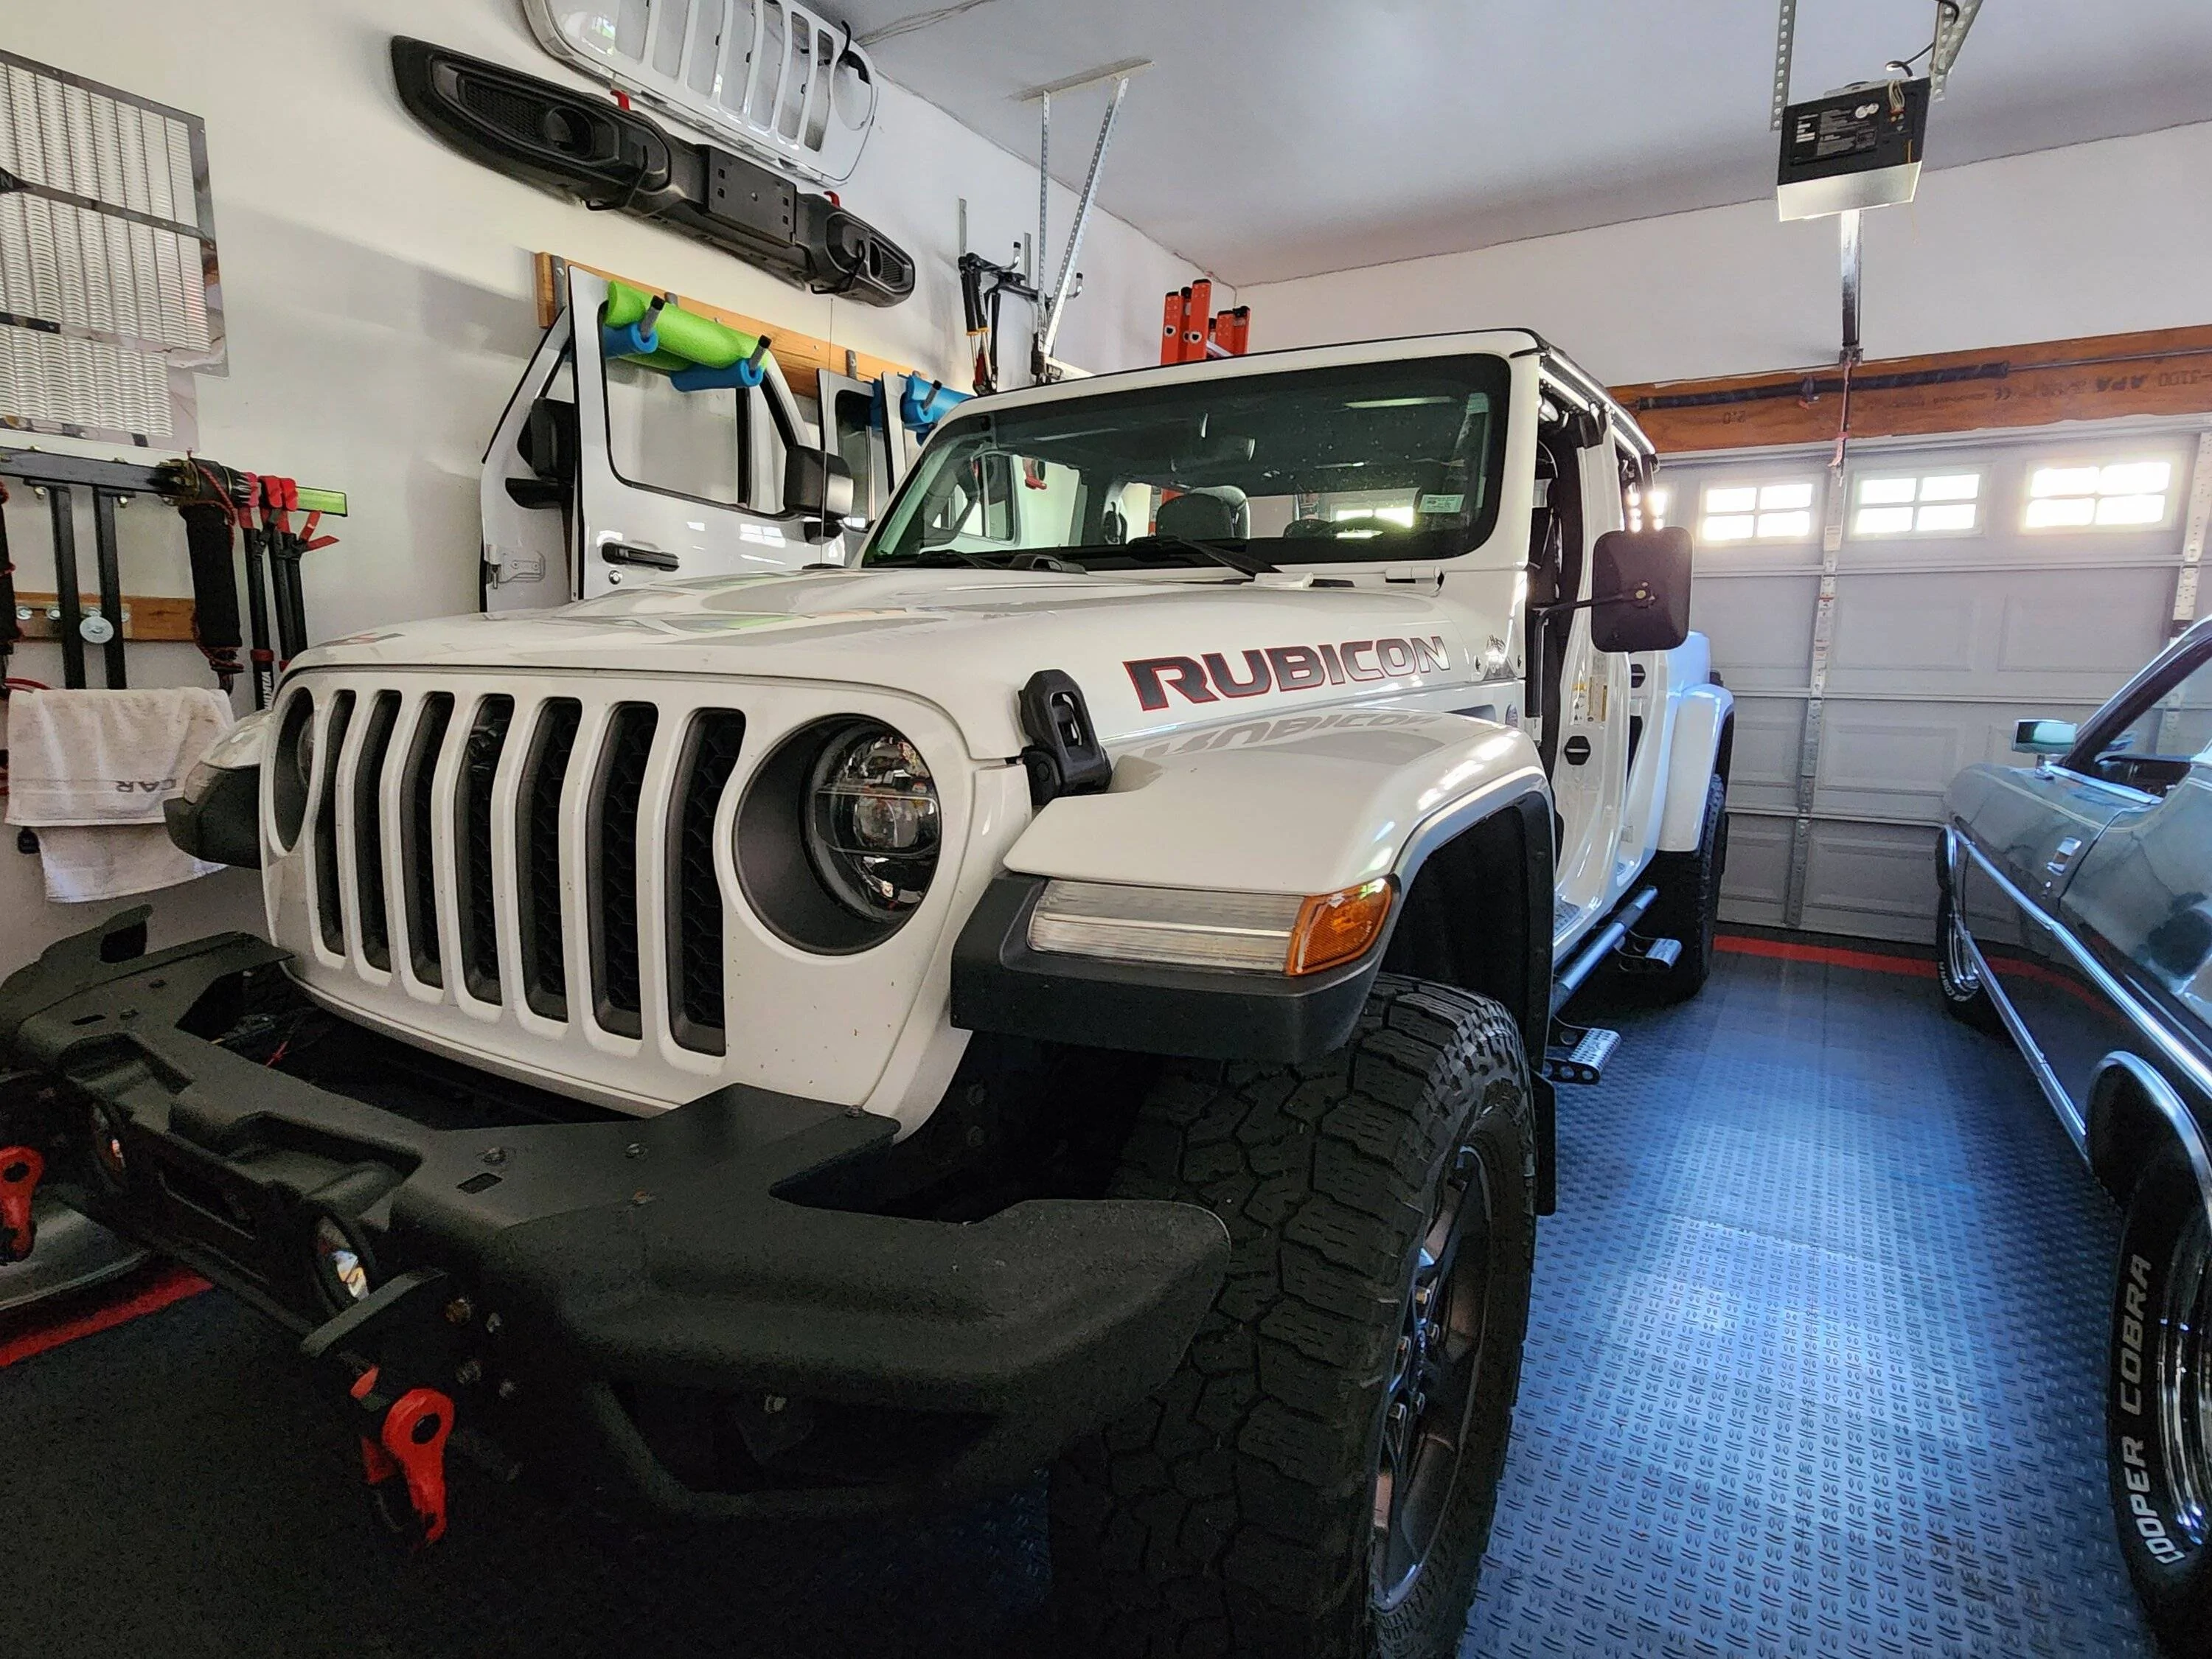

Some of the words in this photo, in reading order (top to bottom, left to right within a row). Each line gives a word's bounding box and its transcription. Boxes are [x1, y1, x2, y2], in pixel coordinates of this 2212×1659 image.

[1122, 636, 1451, 712] RUBICON
[116, 779, 177, 793] CAR
[2120, 1253, 2152, 1416] COBRA
[2121, 1436, 2186, 1564] COOPER
